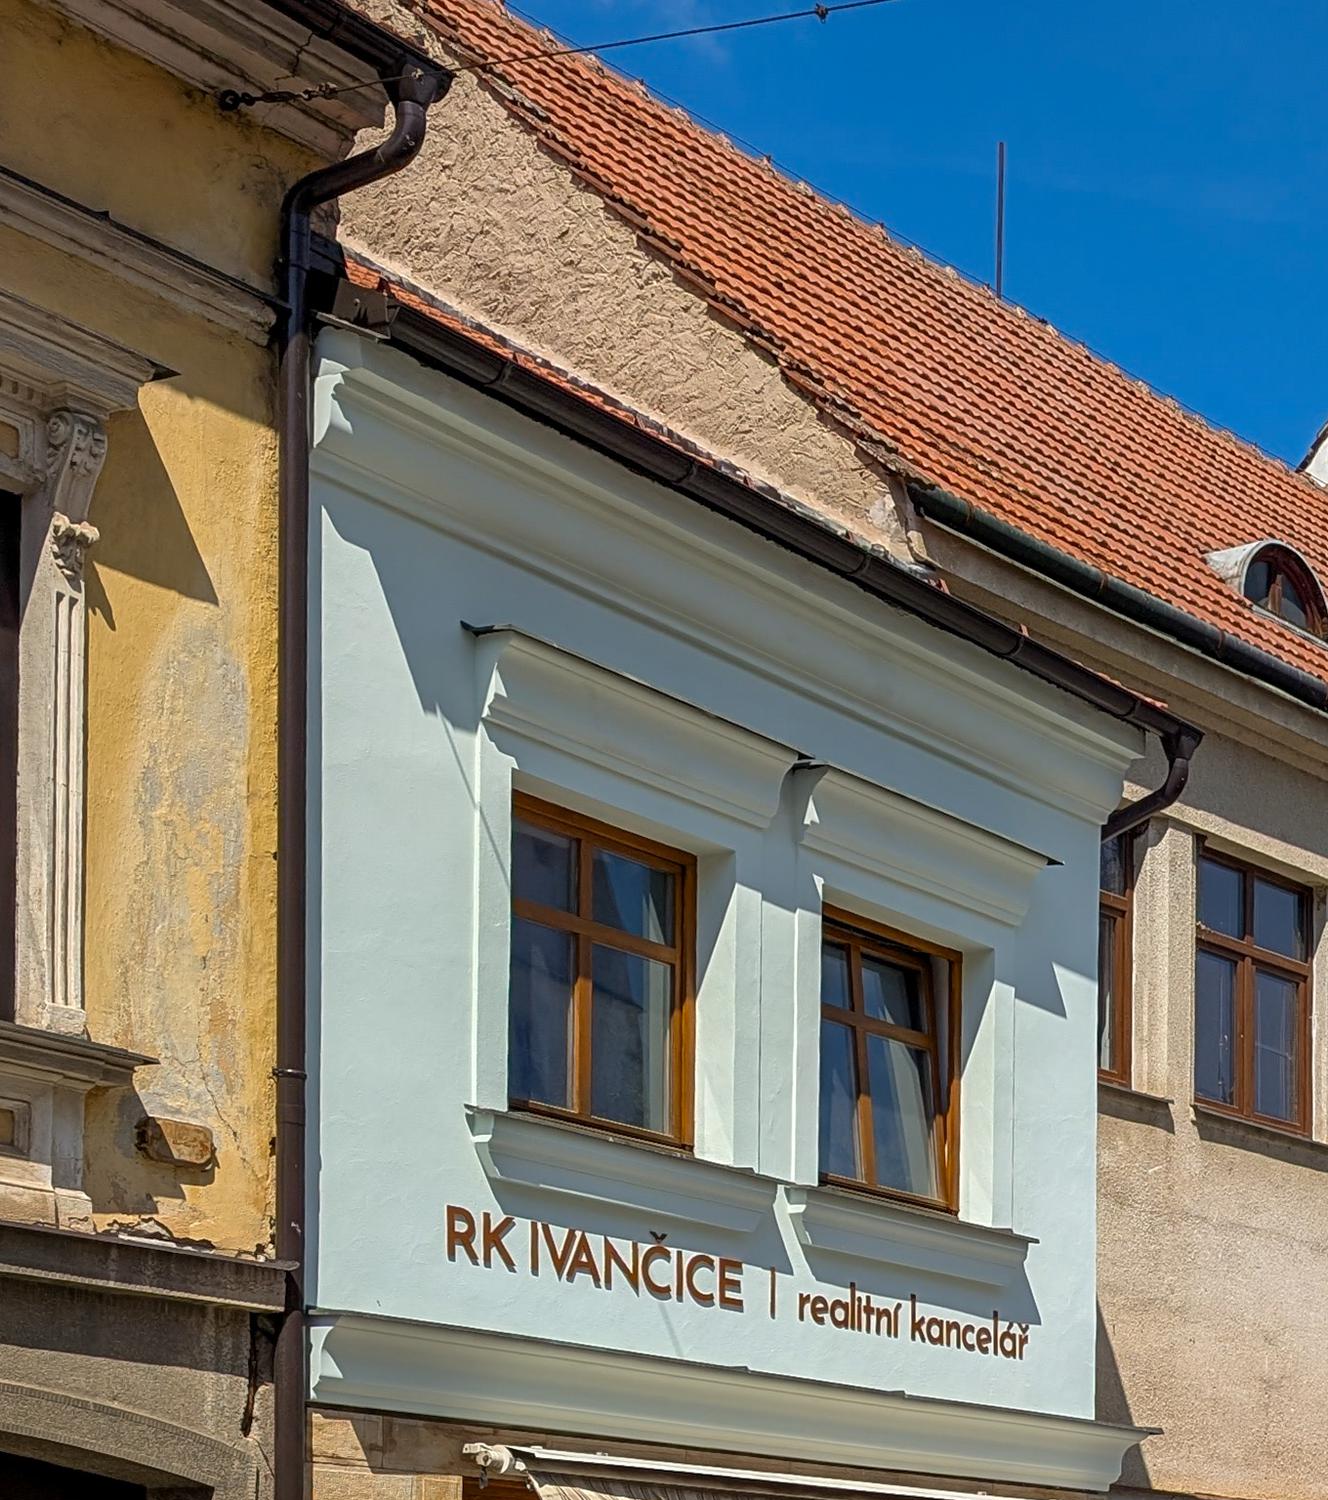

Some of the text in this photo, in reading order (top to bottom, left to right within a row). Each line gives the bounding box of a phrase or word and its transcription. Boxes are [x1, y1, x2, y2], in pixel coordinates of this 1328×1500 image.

[444, 1204, 1031, 1361] RK IVANČICE realitní kancelář
